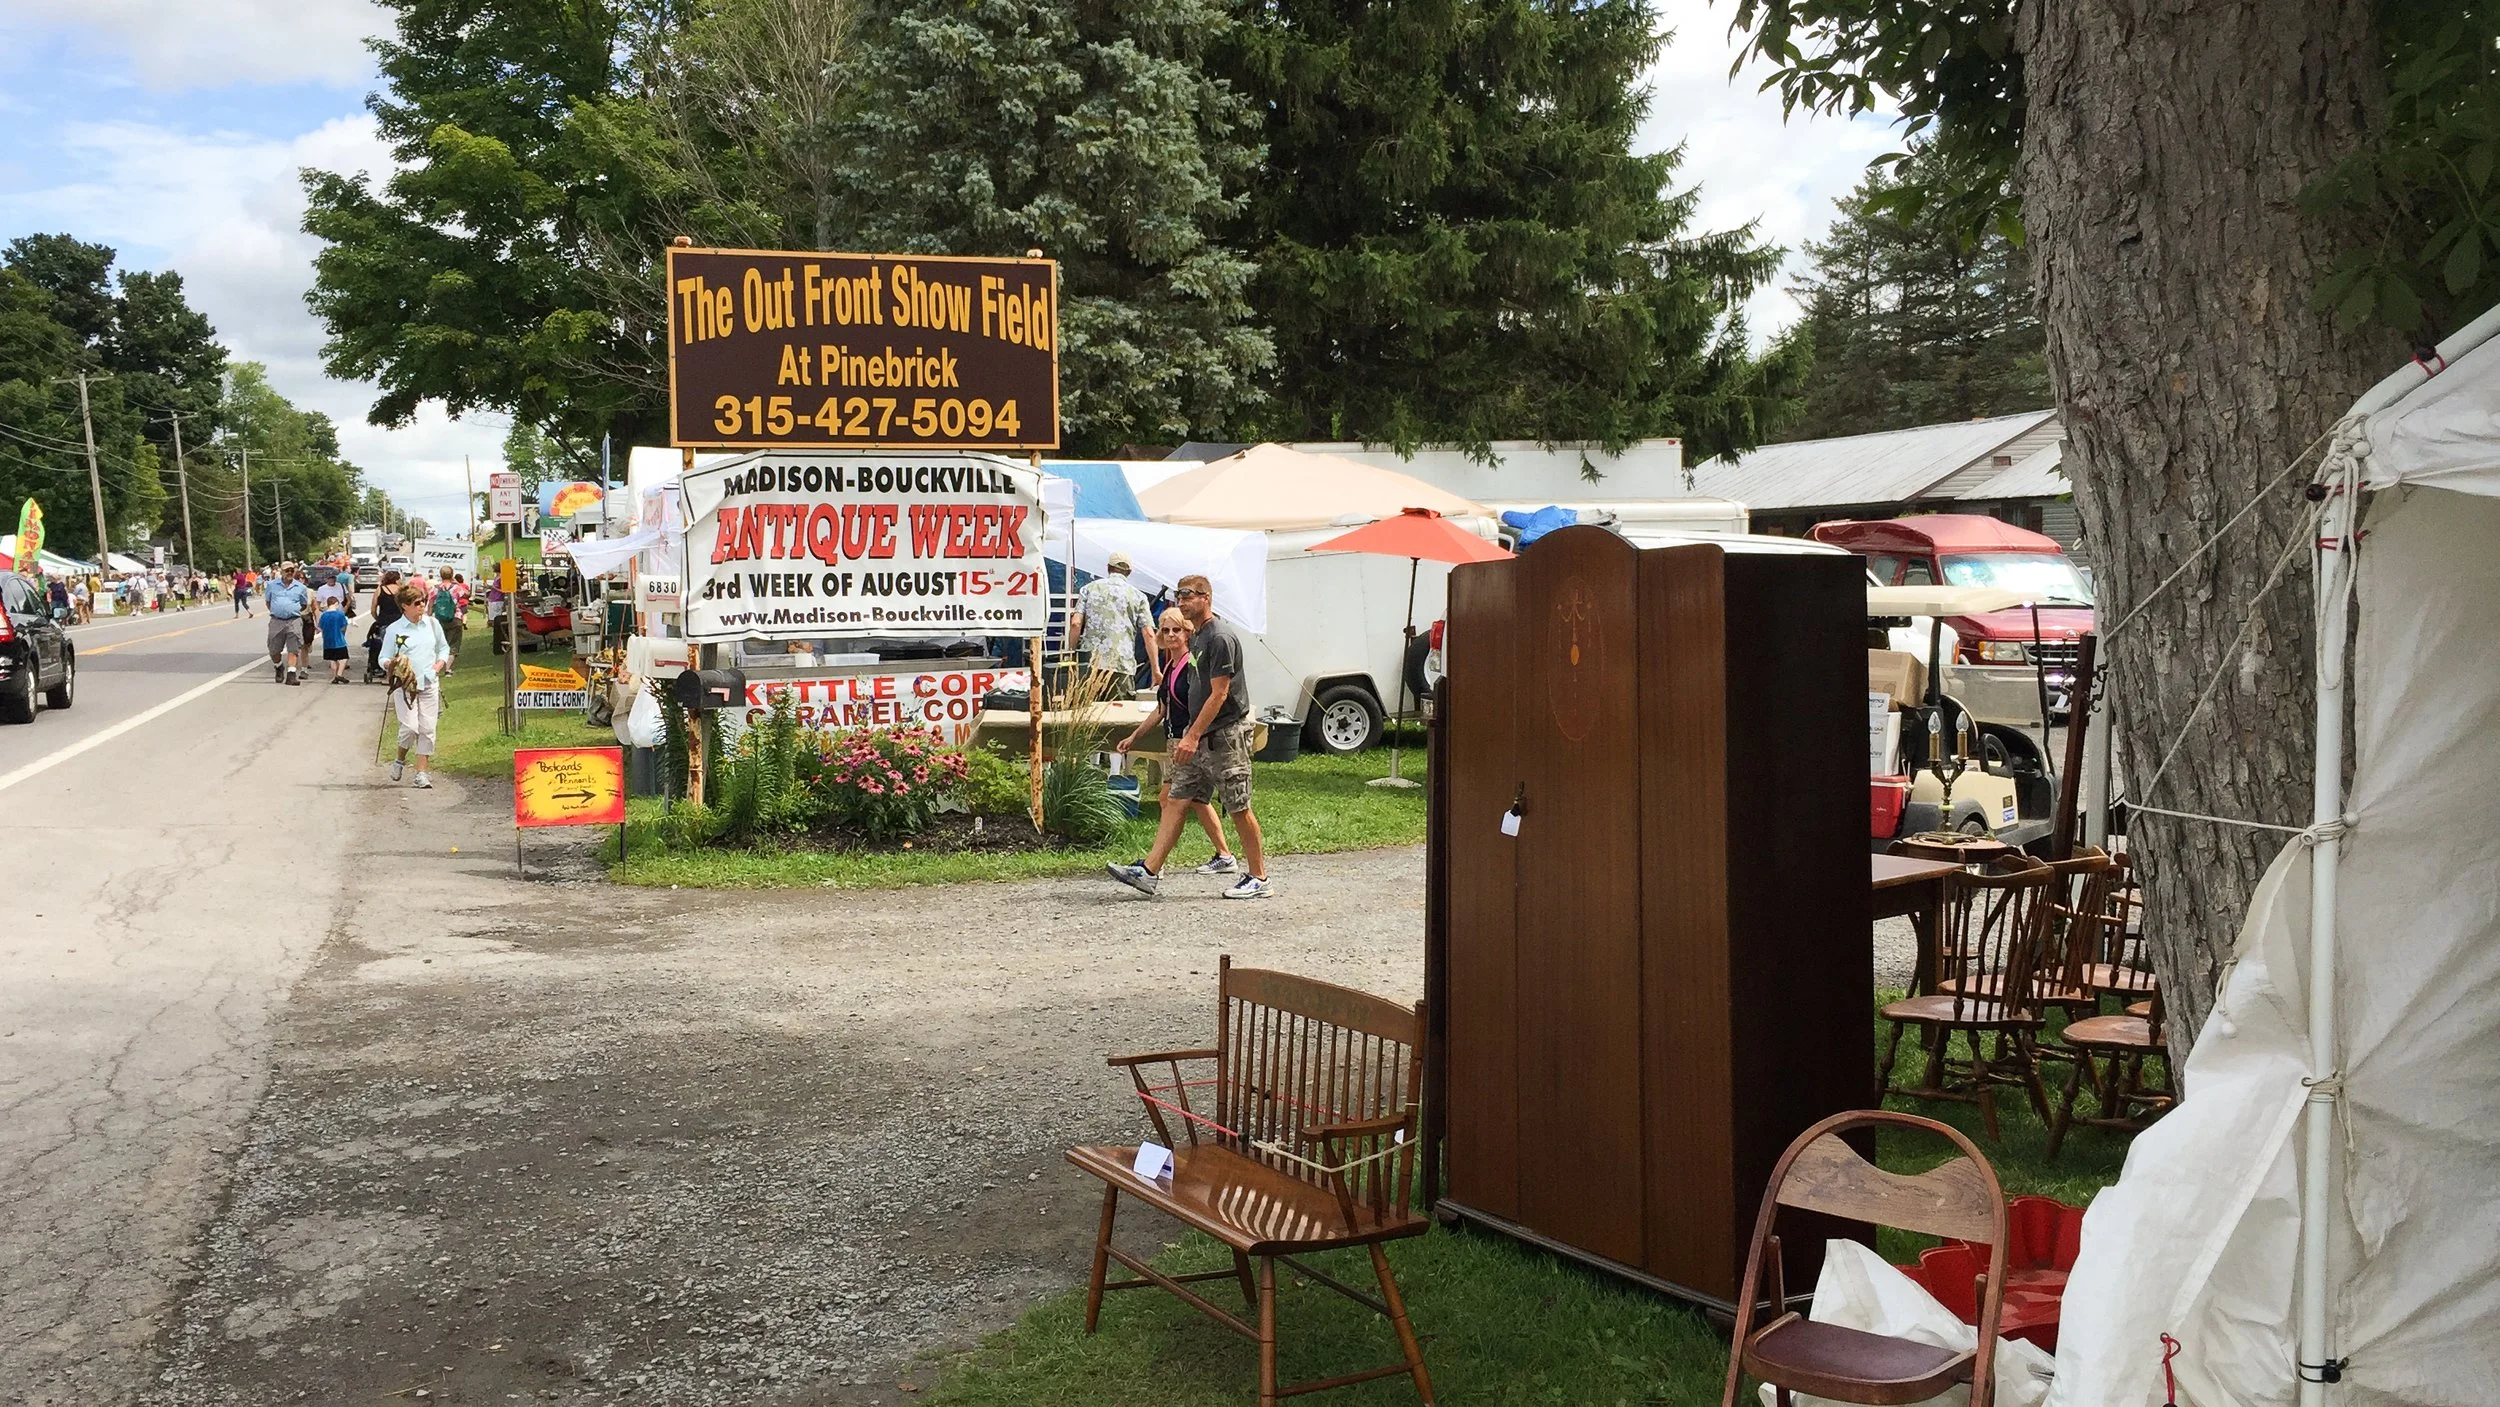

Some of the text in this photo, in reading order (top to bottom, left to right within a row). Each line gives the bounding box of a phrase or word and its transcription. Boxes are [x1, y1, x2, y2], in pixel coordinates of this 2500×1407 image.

[677, 263, 1051, 352] The Out Front Show Field
[777, 344, 960, 388] At Pinebrick
[714, 395, 1021, 437] 315-427-5094
[724, 465, 1016, 499] MADISON-BOUCKVILLE
[710, 502, 1029, 567] ANTIQUE WEEK
[423, 551, 466, 560] PENSKE
[649, 581, 677, 593] 6830
[702, 573, 741, 600] 3rd
[750, 572, 814, 597] WEEK
[821, 572, 853, 597] OF
[861, 571, 957, 597] AUGUST
[719, 605, 1023, 627] www.Madison-Bouckville.com
[517, 692, 586, 707] GOT KETTLE CORN?
[745, 672, 1024, 706] KETTLE COR
[746, 701, 913, 727] CRAMEL
[536, 761, 582, 773] Postcards
